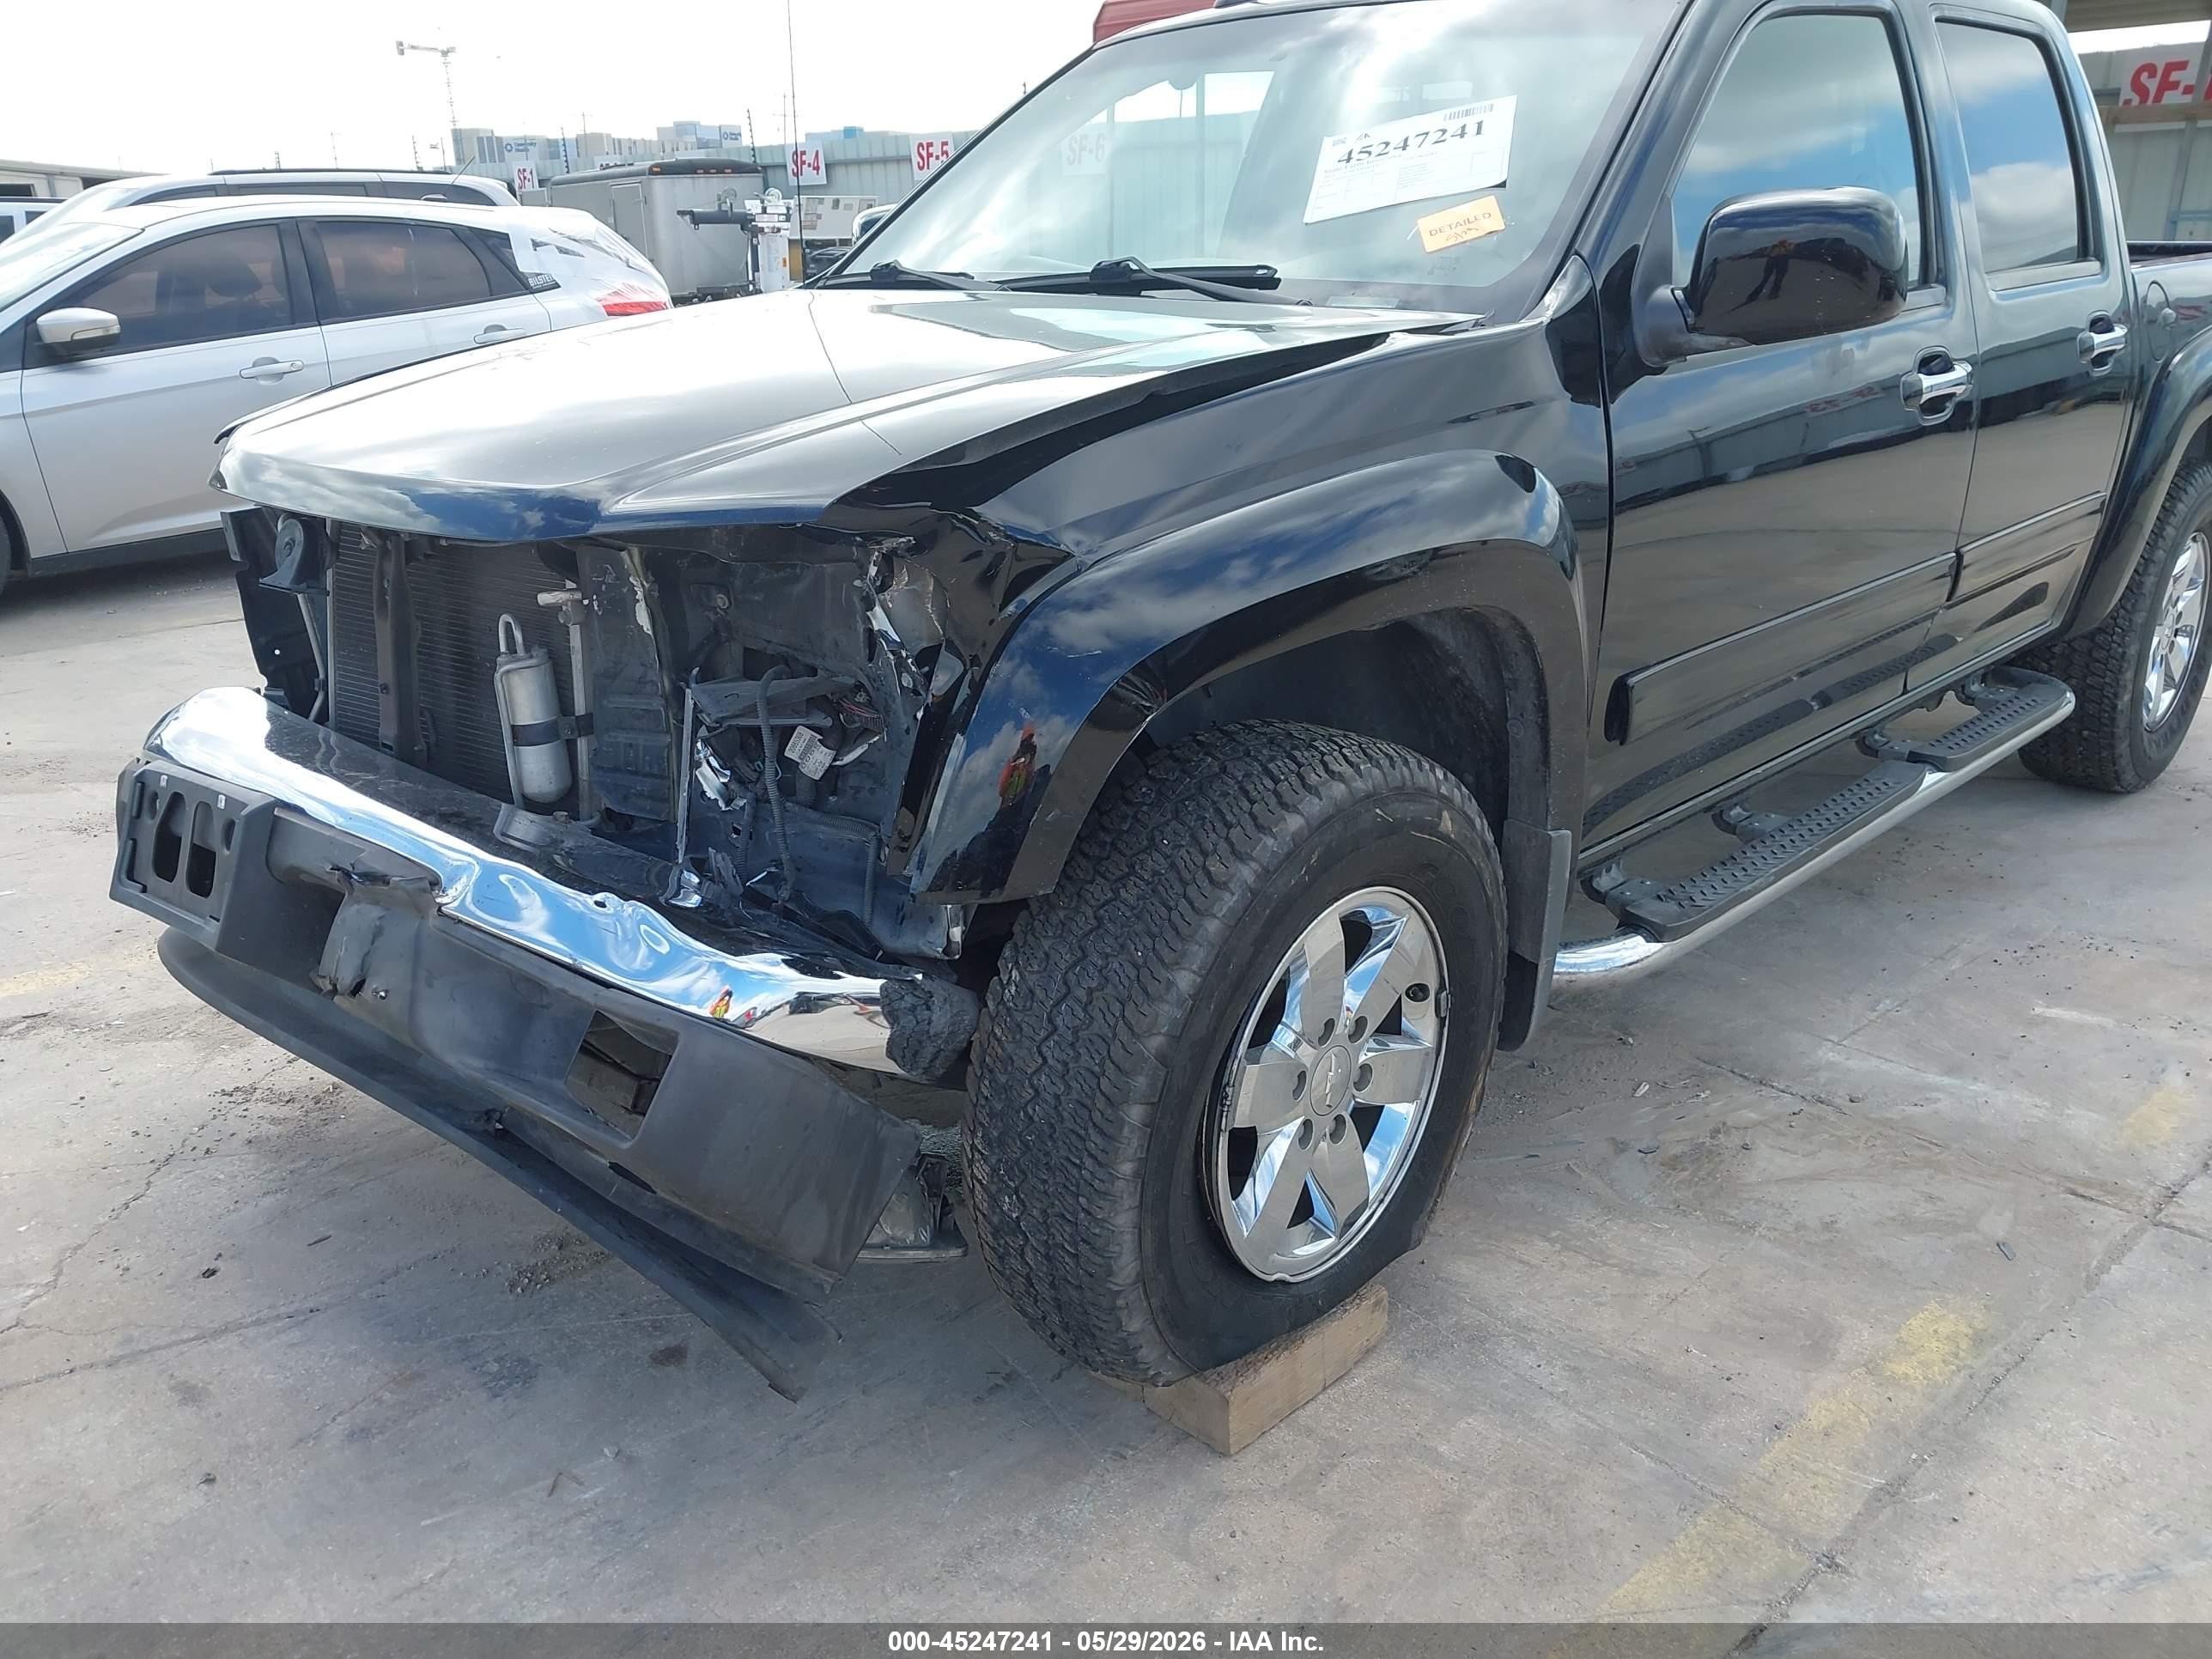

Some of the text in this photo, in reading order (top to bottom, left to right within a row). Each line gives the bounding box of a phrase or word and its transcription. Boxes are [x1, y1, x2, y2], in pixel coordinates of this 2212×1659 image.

[2122, 59, 2212, 105] SF-
[916, 140, 949, 172] SF-5
[1337, 119, 1485, 164] 45247241
[792, 149, 821, 178] SF-4
[517, 167, 535, 190] SF-1
[1429, 212, 1492, 236] DETAILED
[528, 274, 554, 286] BILSTEI
